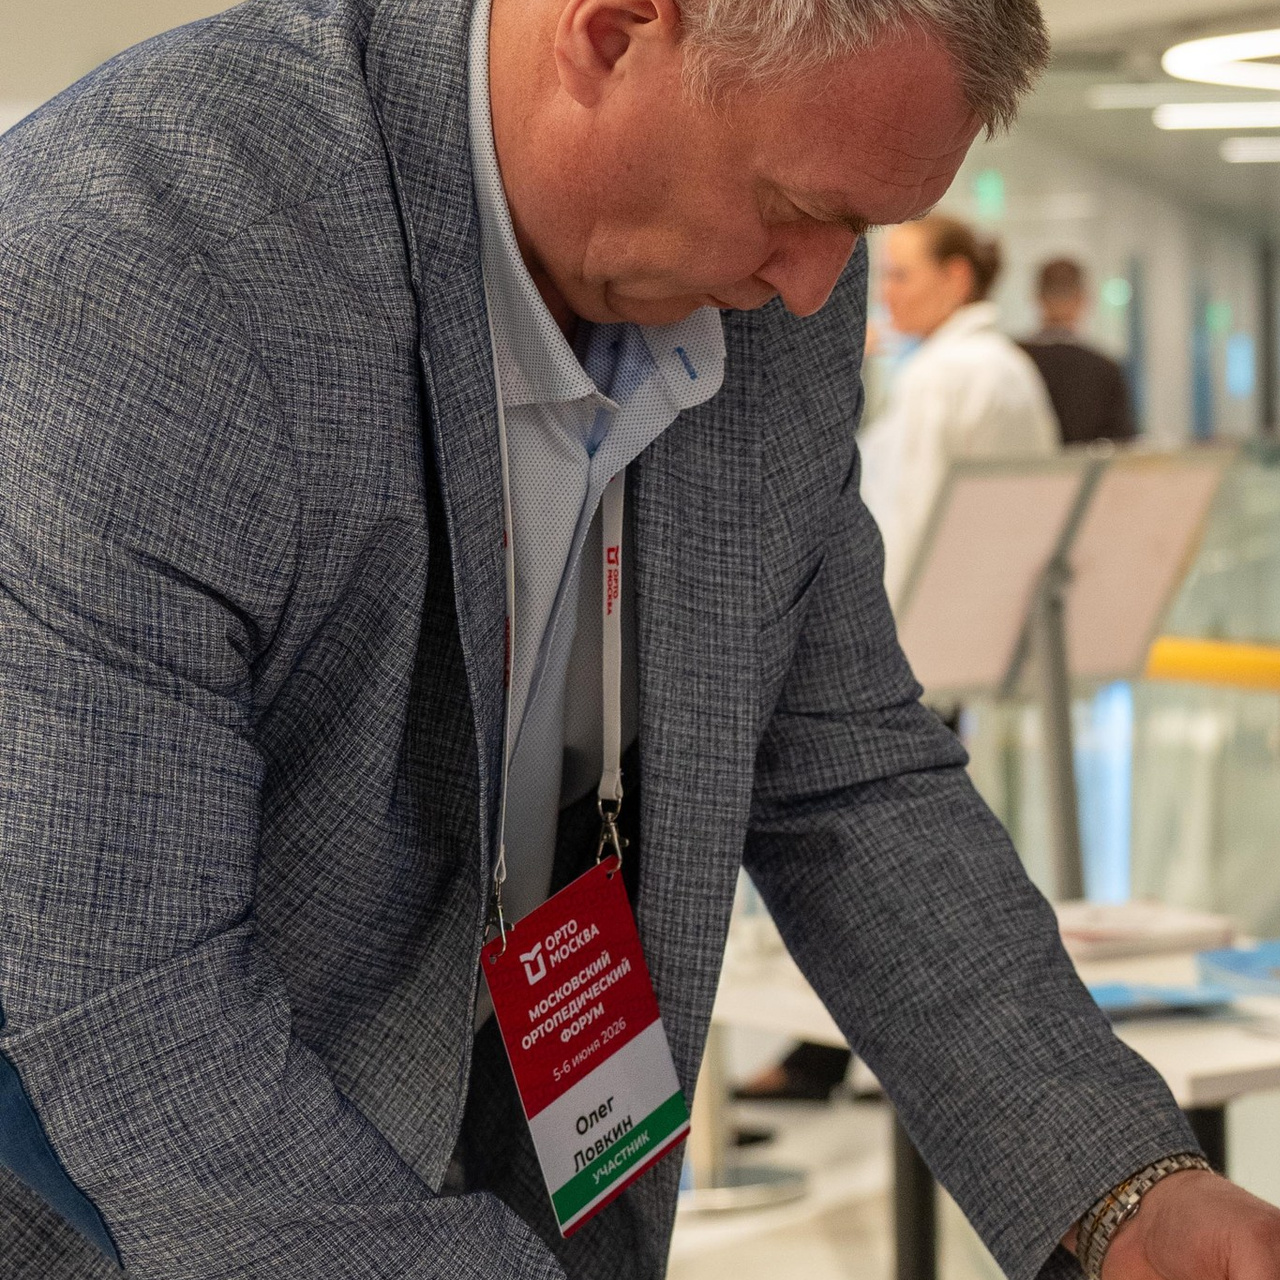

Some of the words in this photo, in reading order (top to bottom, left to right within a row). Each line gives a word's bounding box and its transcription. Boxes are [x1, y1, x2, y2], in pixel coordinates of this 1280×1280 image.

[545, 919, 578, 951] ОРТО
[549, 923, 600, 968] МОСКВА
[521, 957, 631, 1050] ОРТОПЕДИЧЕСКИЙ
[528, 950, 611, 1022] МОСКОВСКИЙ
[552, 1059, 571, 1081] 5-6
[571, 1039, 601, 1068] июня
[600, 1016, 627, 1045] 2026
[560, 1001, 605, 1043] ФОРУМ
[573, 1114, 634, 1173] Ловкин
[575, 1096, 614, 1135] Олег
[592, 1129, 650, 1185] УЧАСТНИК
